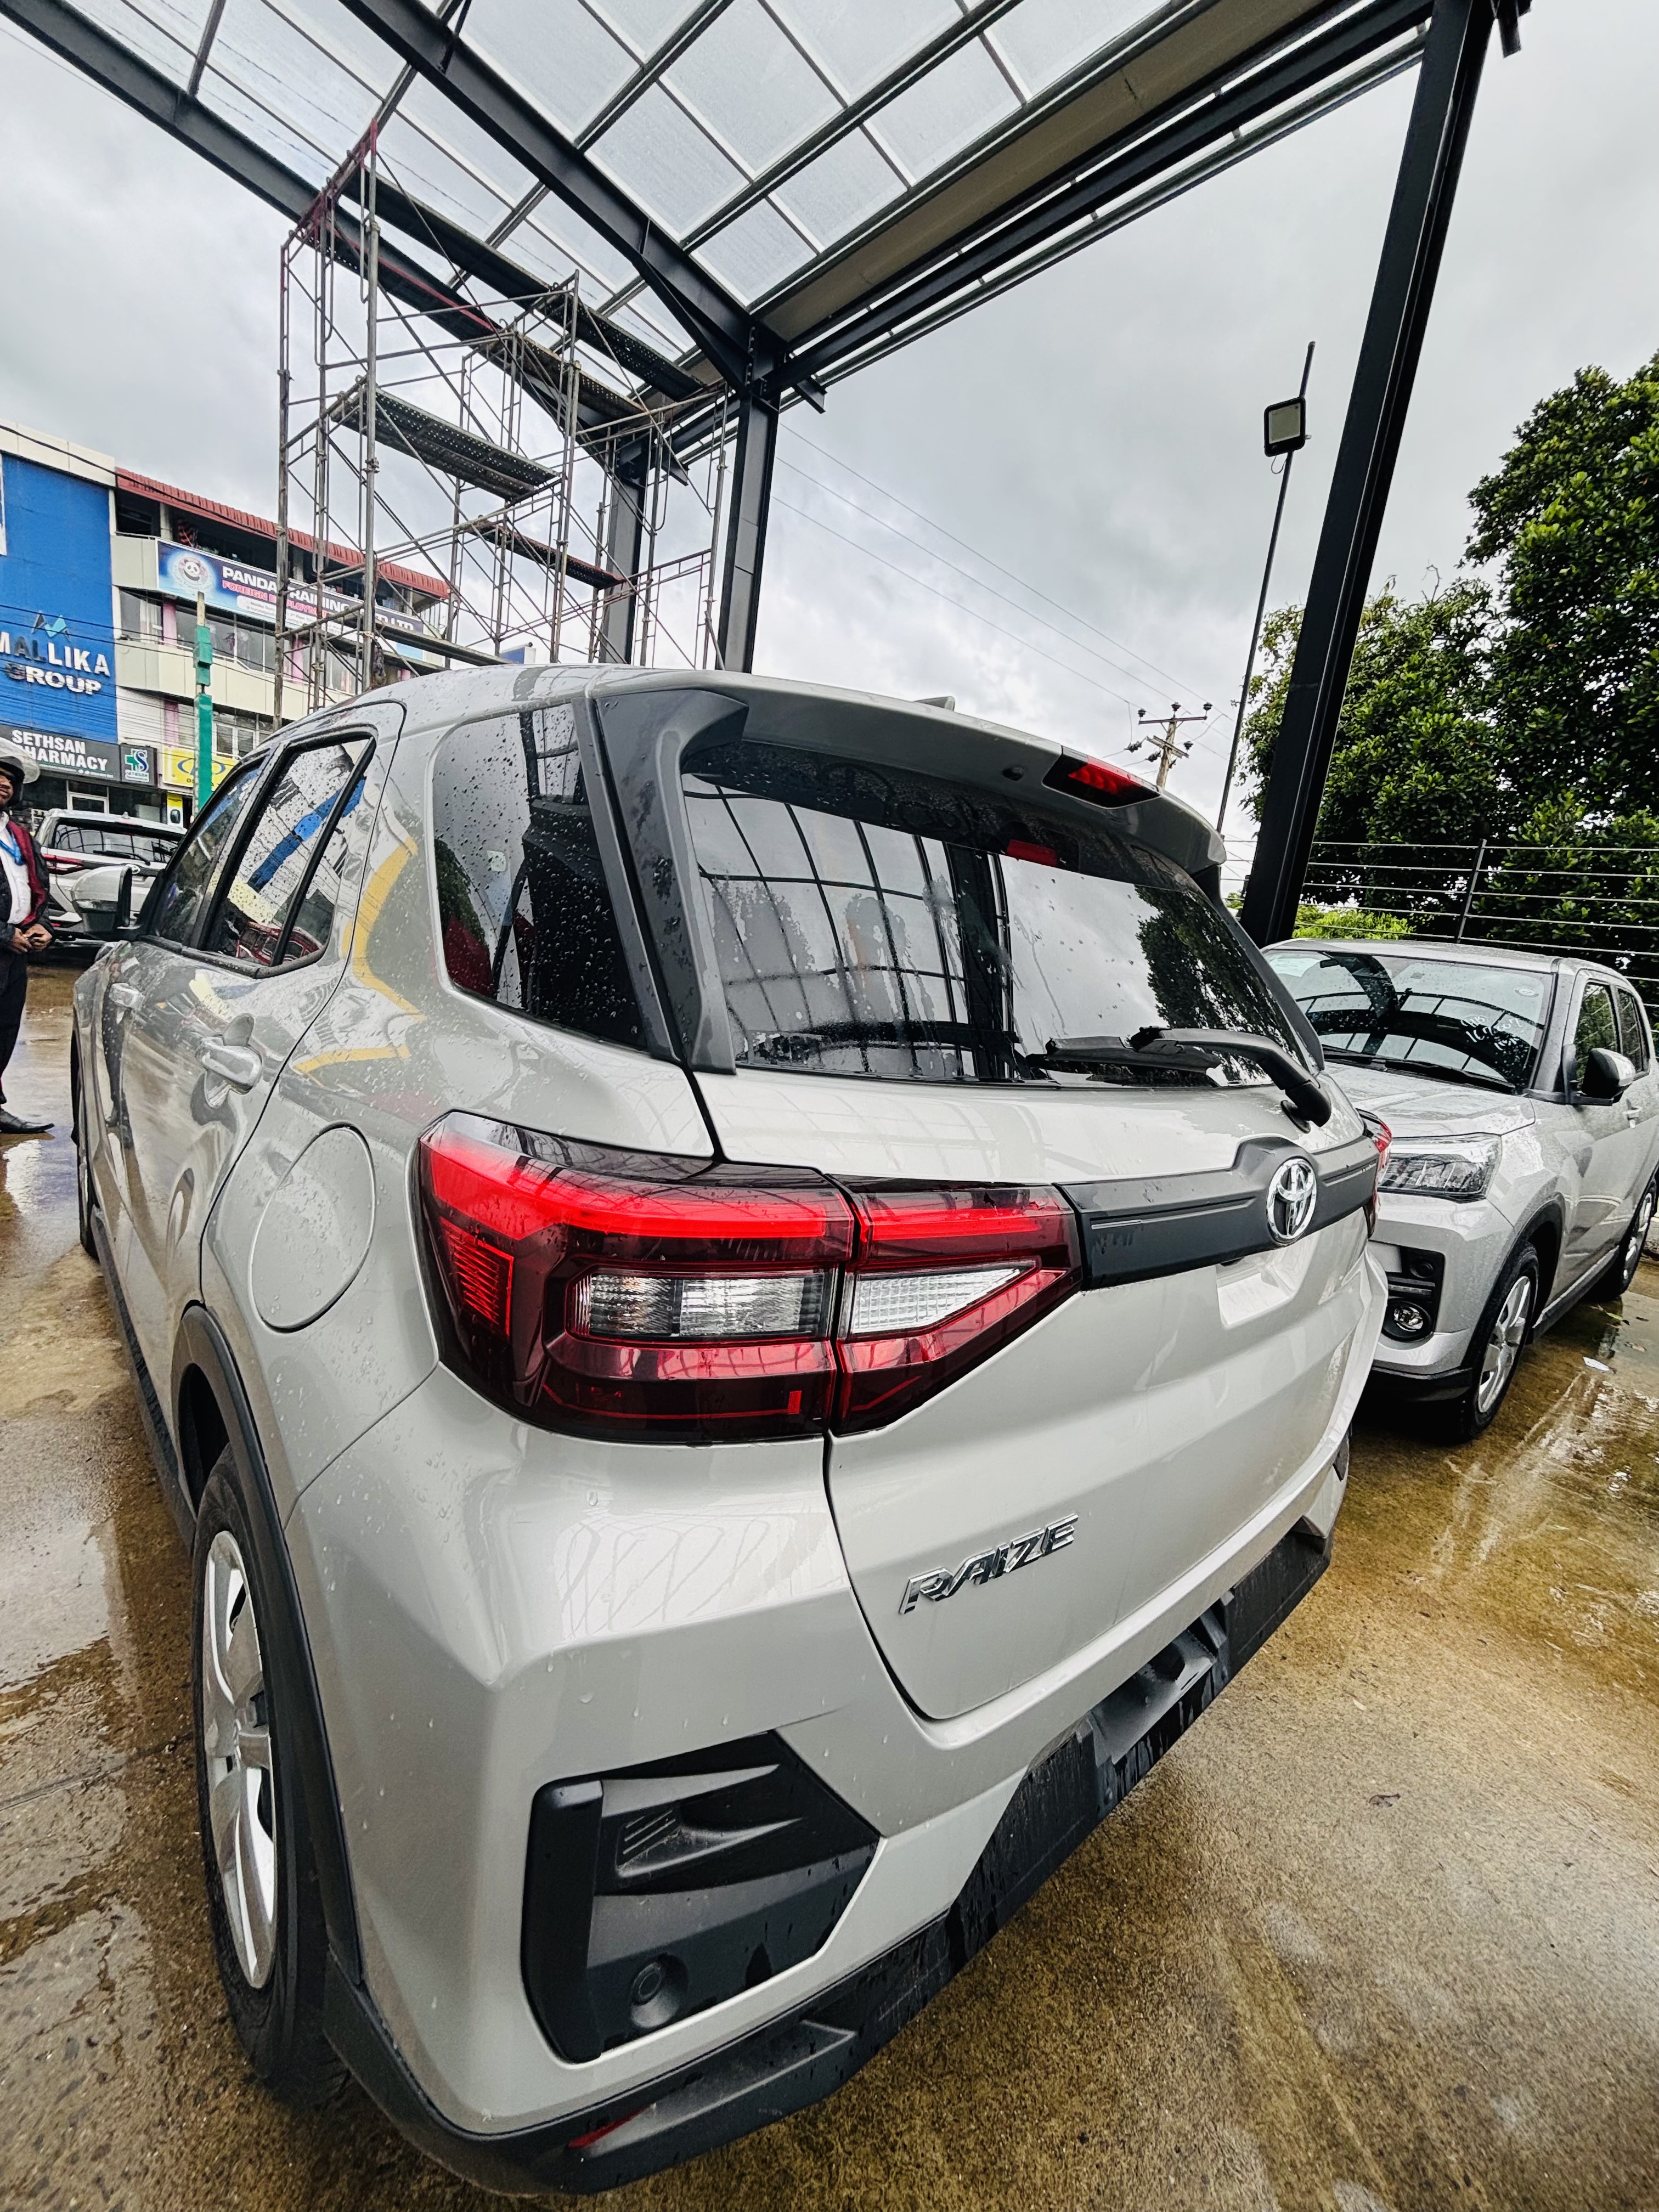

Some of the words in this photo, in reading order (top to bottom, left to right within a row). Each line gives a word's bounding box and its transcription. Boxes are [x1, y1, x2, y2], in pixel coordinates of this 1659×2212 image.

[222, 566, 278, 594] PANDA
[222, 579, 268, 601] FOREIGN
[4, 661, 102, 695] GROUP
[12, 730, 86, 755] SETHSAN
[20, 745, 108, 771] HARMACY
[898, 1513, 1079, 1615] RAIZE
